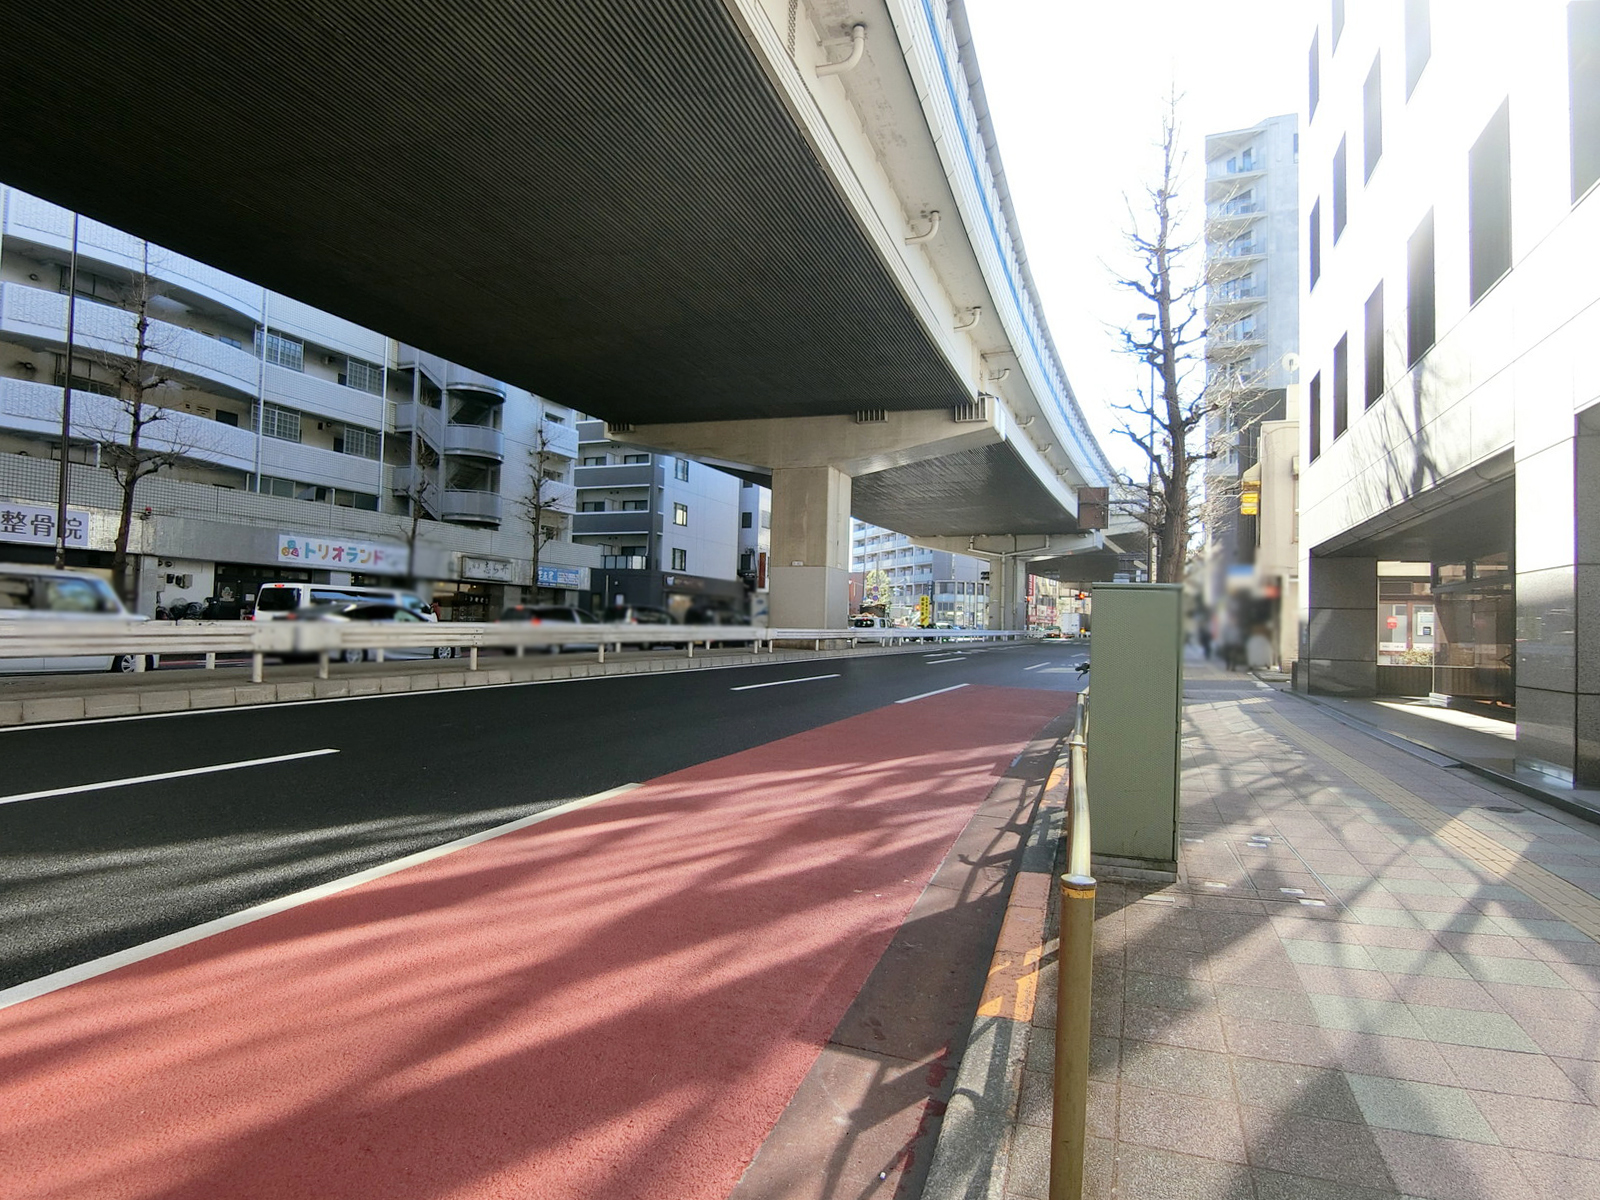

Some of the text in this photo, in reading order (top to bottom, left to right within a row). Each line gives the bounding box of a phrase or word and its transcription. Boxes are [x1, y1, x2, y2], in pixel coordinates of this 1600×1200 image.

[1, 510, 82, 541] 整骨院
[304, 541, 385, 565] トリオランド
